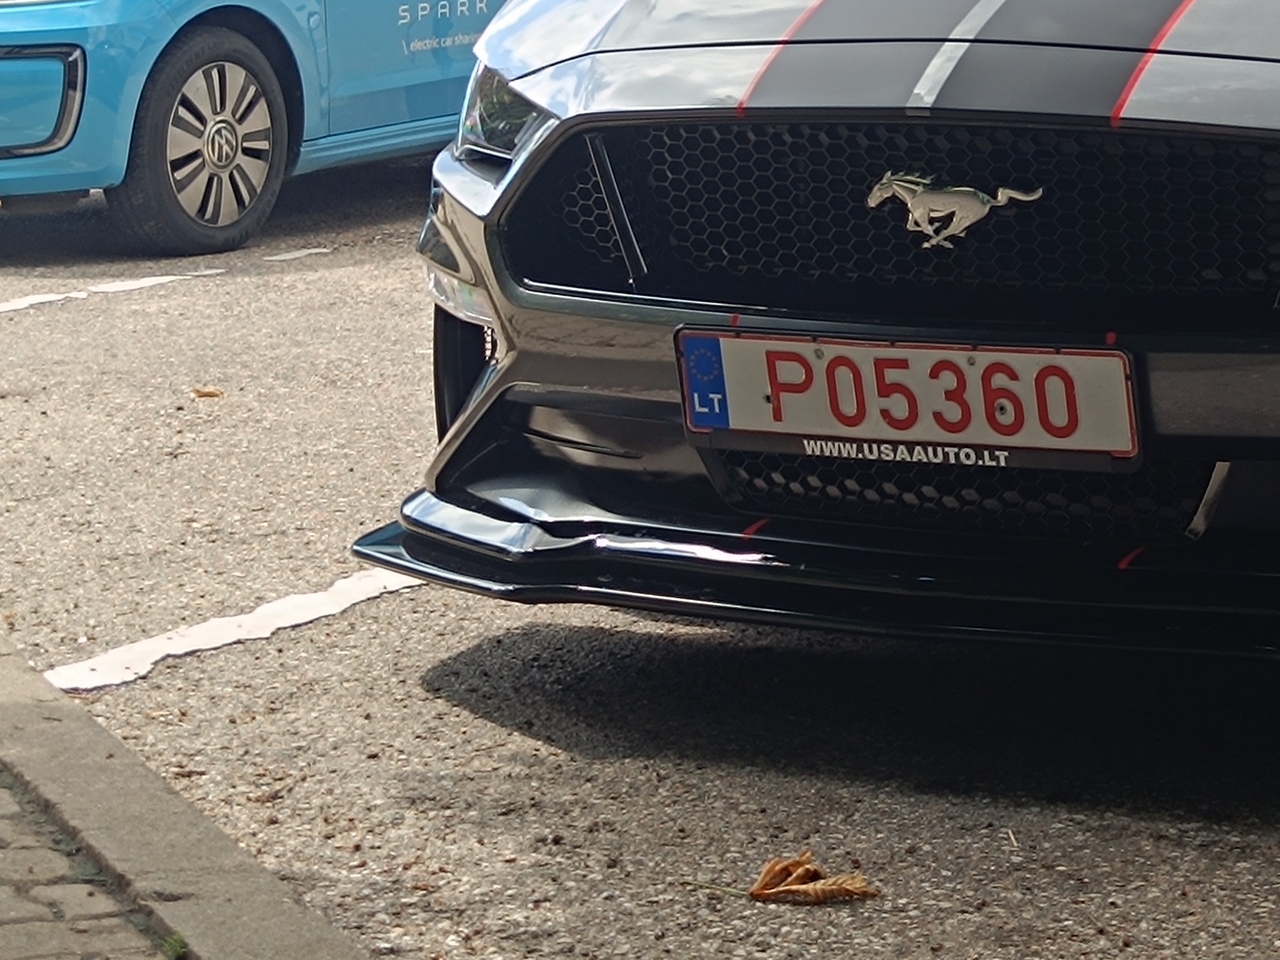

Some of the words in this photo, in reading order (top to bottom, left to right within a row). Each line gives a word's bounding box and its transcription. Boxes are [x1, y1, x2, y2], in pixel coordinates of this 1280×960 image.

[694, 390, 723, 415] LT
[764, 350, 1079, 439] P05360
[803, 439, 1009, 467] WWW.USAAUTO.LT
